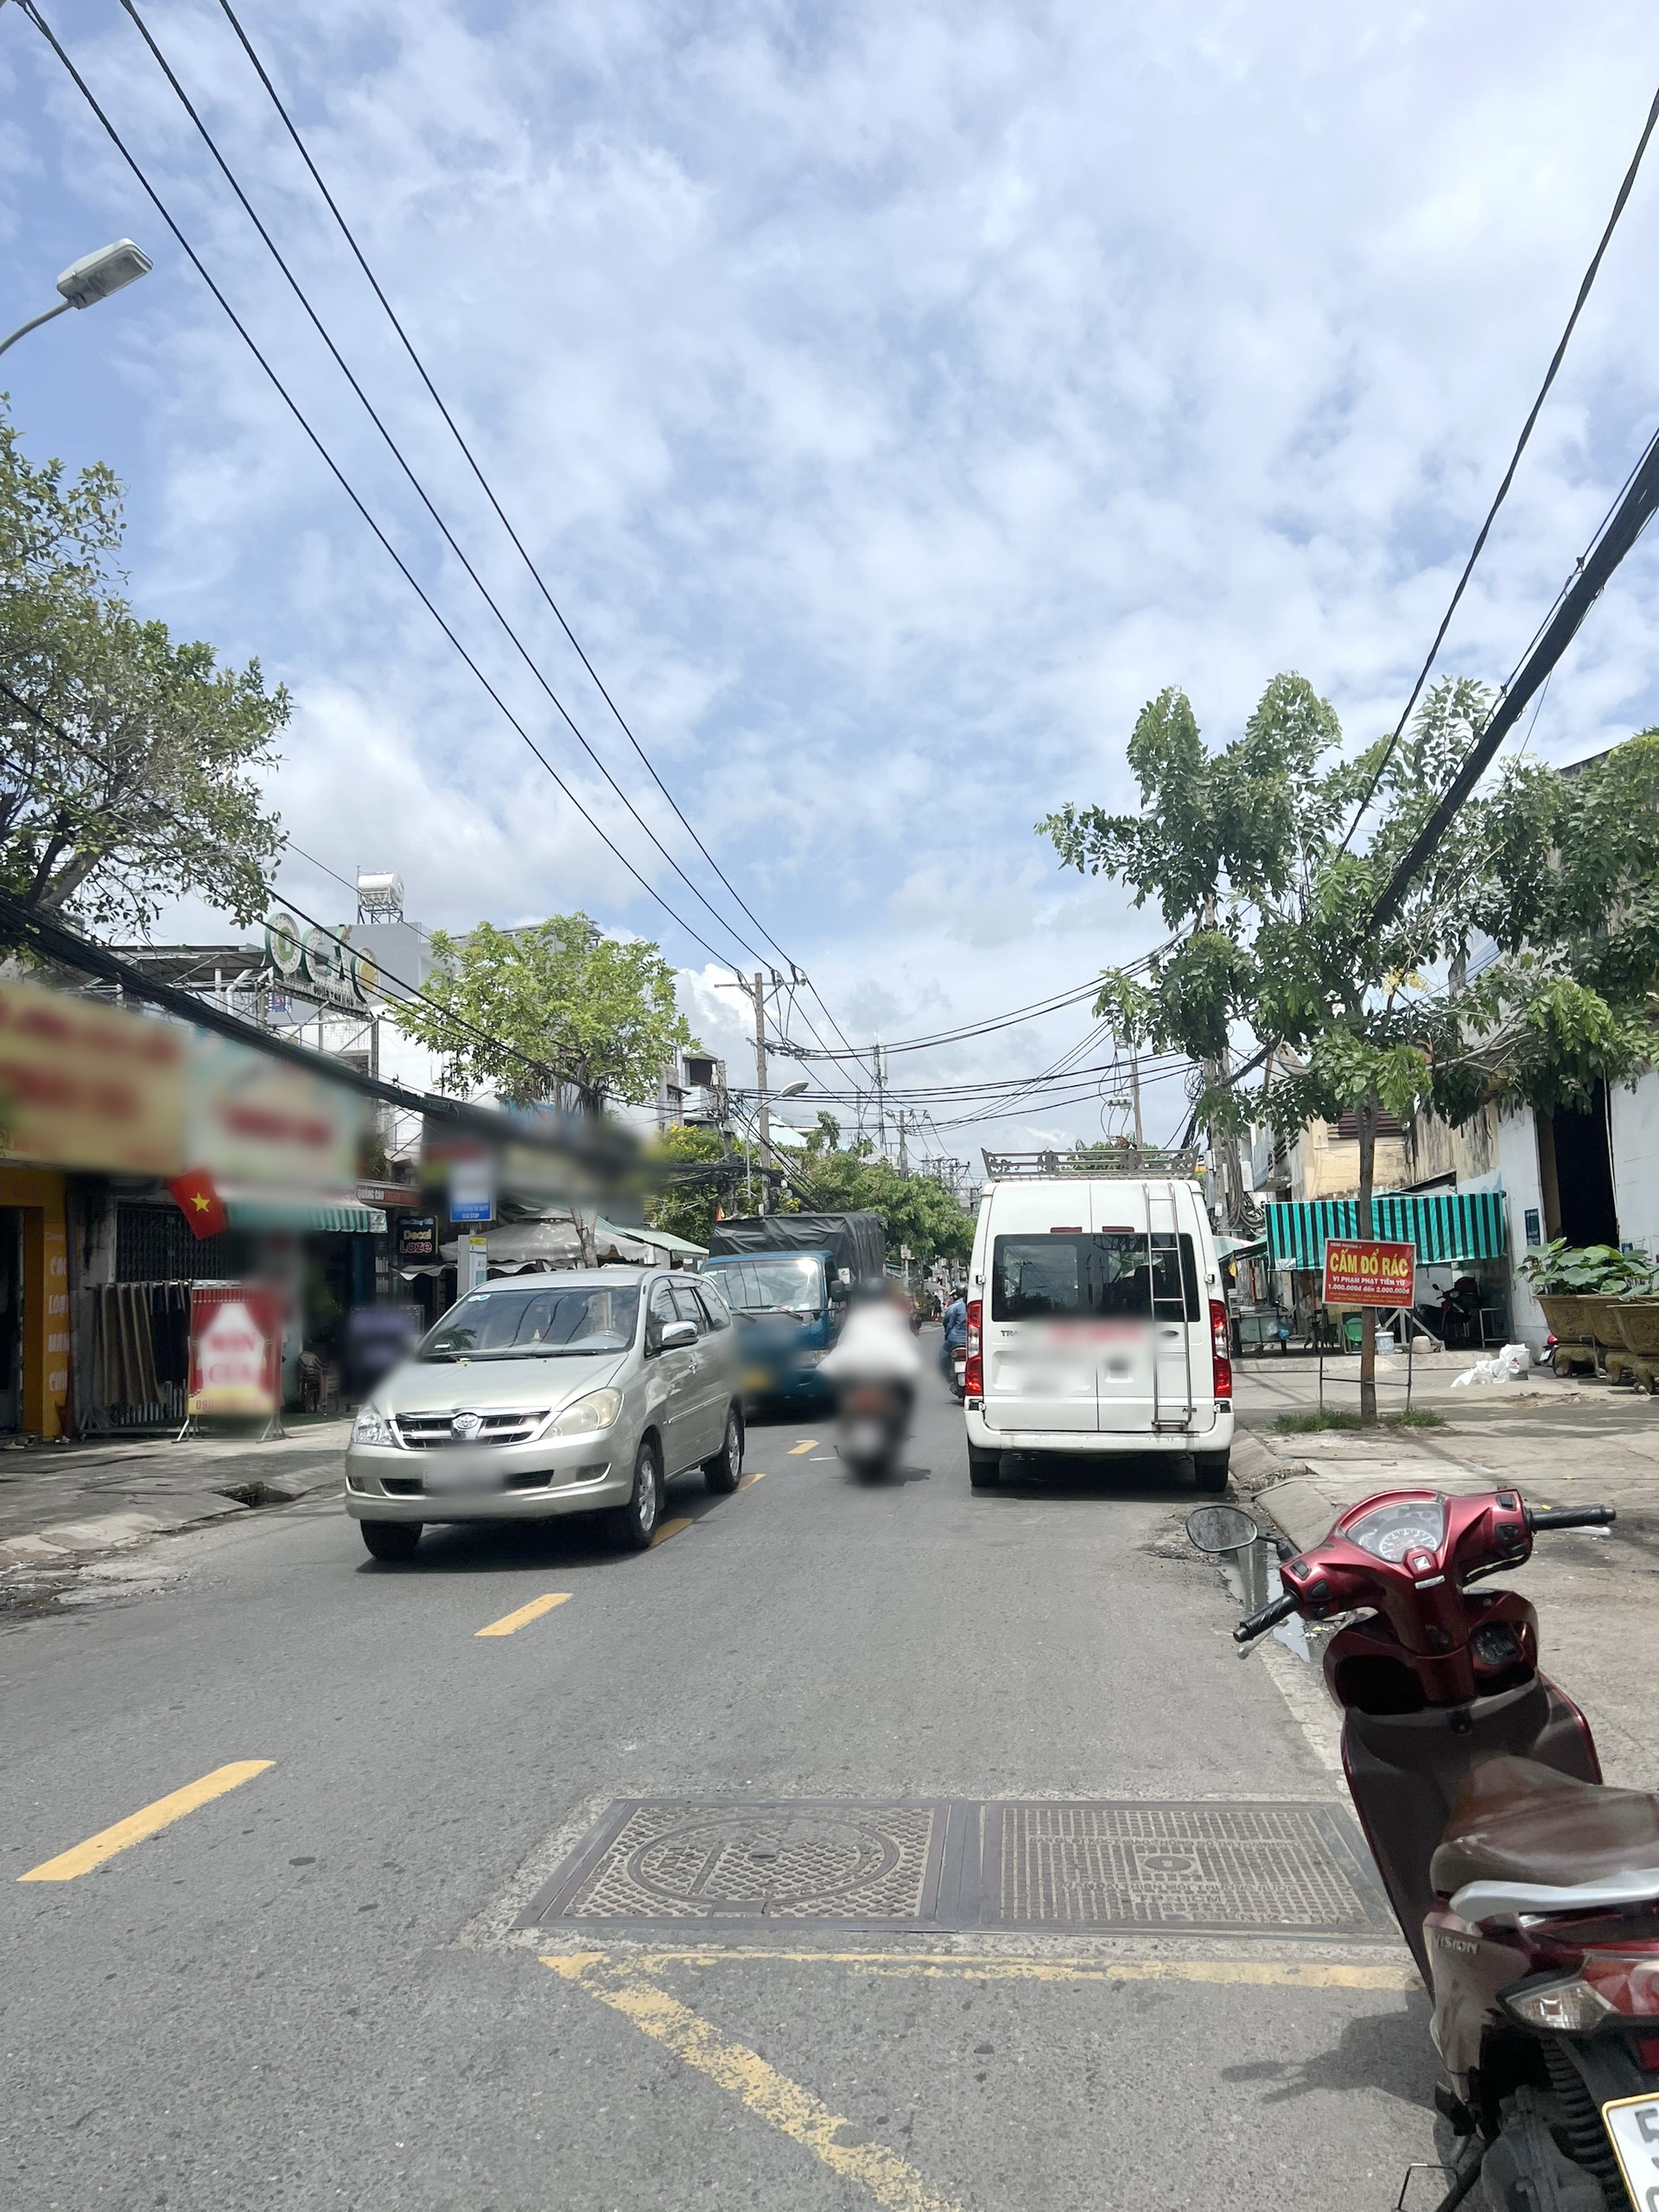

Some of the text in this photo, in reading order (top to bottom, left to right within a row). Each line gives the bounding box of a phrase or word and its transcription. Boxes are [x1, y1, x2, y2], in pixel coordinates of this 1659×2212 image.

[404, 1229, 431, 1240] Decal
[400, 1240, 432, 1253] Laze
[1330, 1248, 1408, 1277] CẤM ĐỔ RÁC
[1433, 1936, 1478, 1955] VISION
